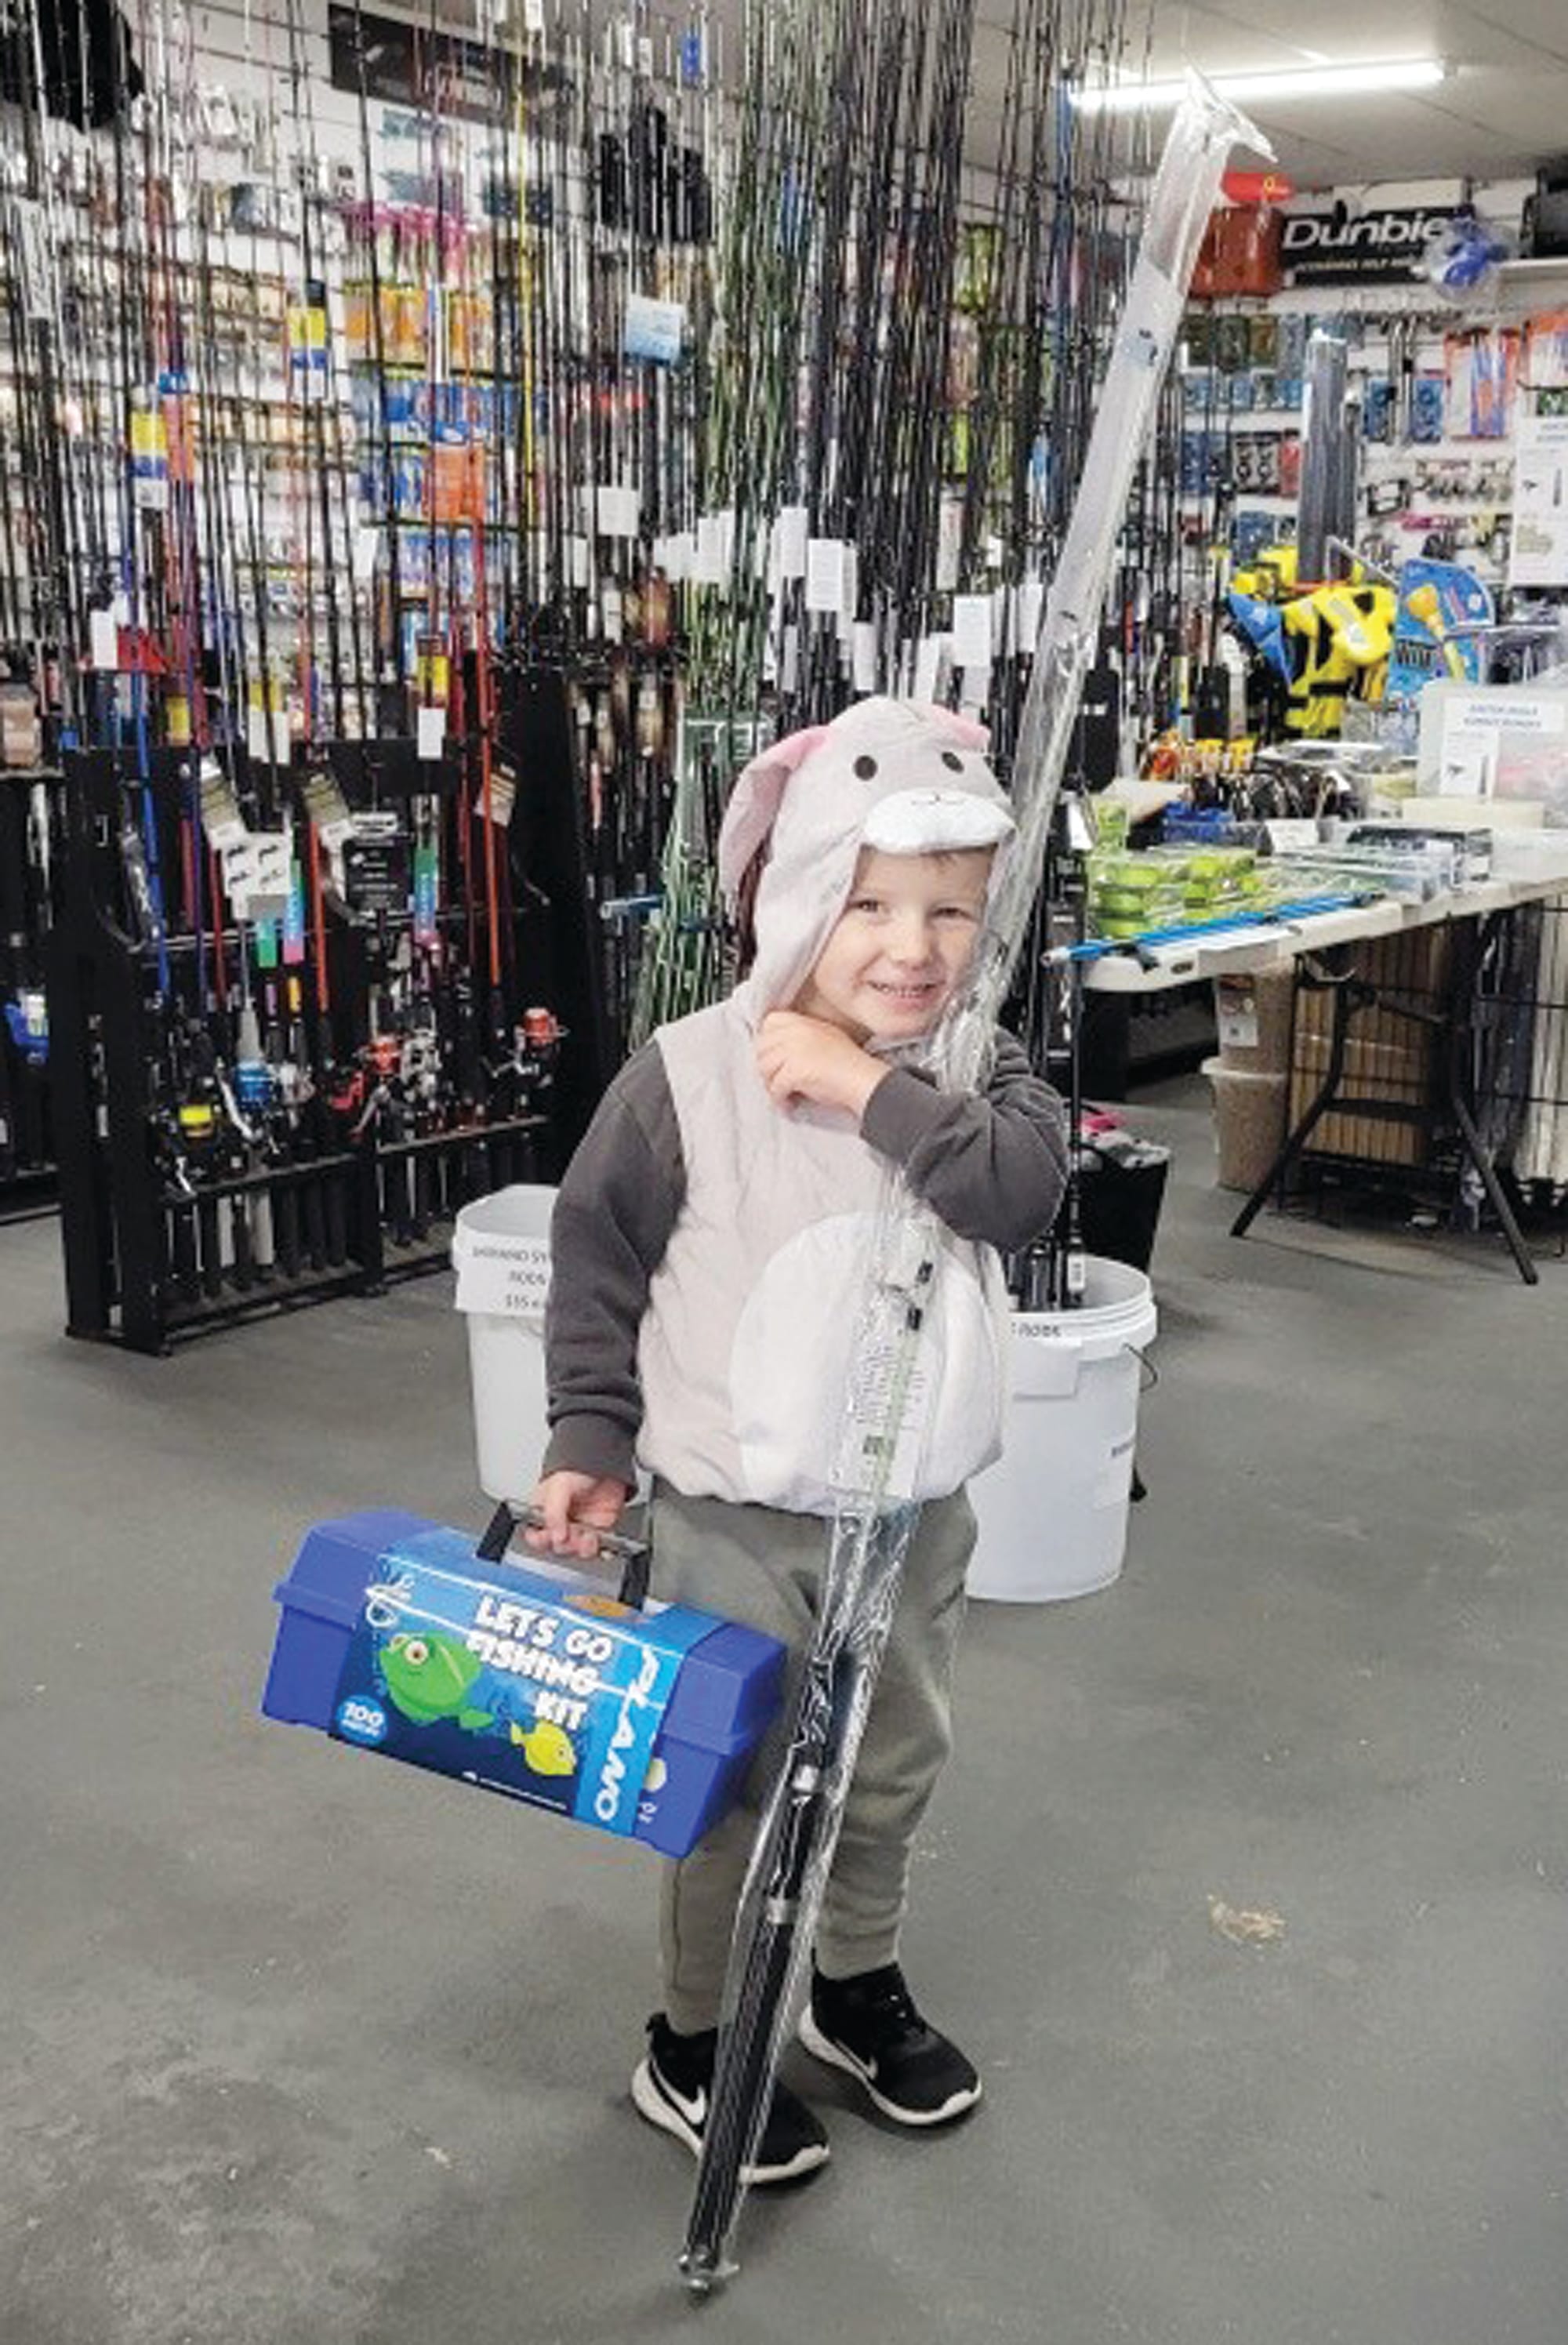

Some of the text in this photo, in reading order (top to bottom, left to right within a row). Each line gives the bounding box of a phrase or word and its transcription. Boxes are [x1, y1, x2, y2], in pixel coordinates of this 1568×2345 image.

[1282, 210, 1452, 250] Dunbie
[466, 1629, 599, 1696] FISHING
[565, 1628, 612, 1663] GO
[534, 1689, 589, 1730] KIT
[593, 1644, 660, 1822] PLANO
